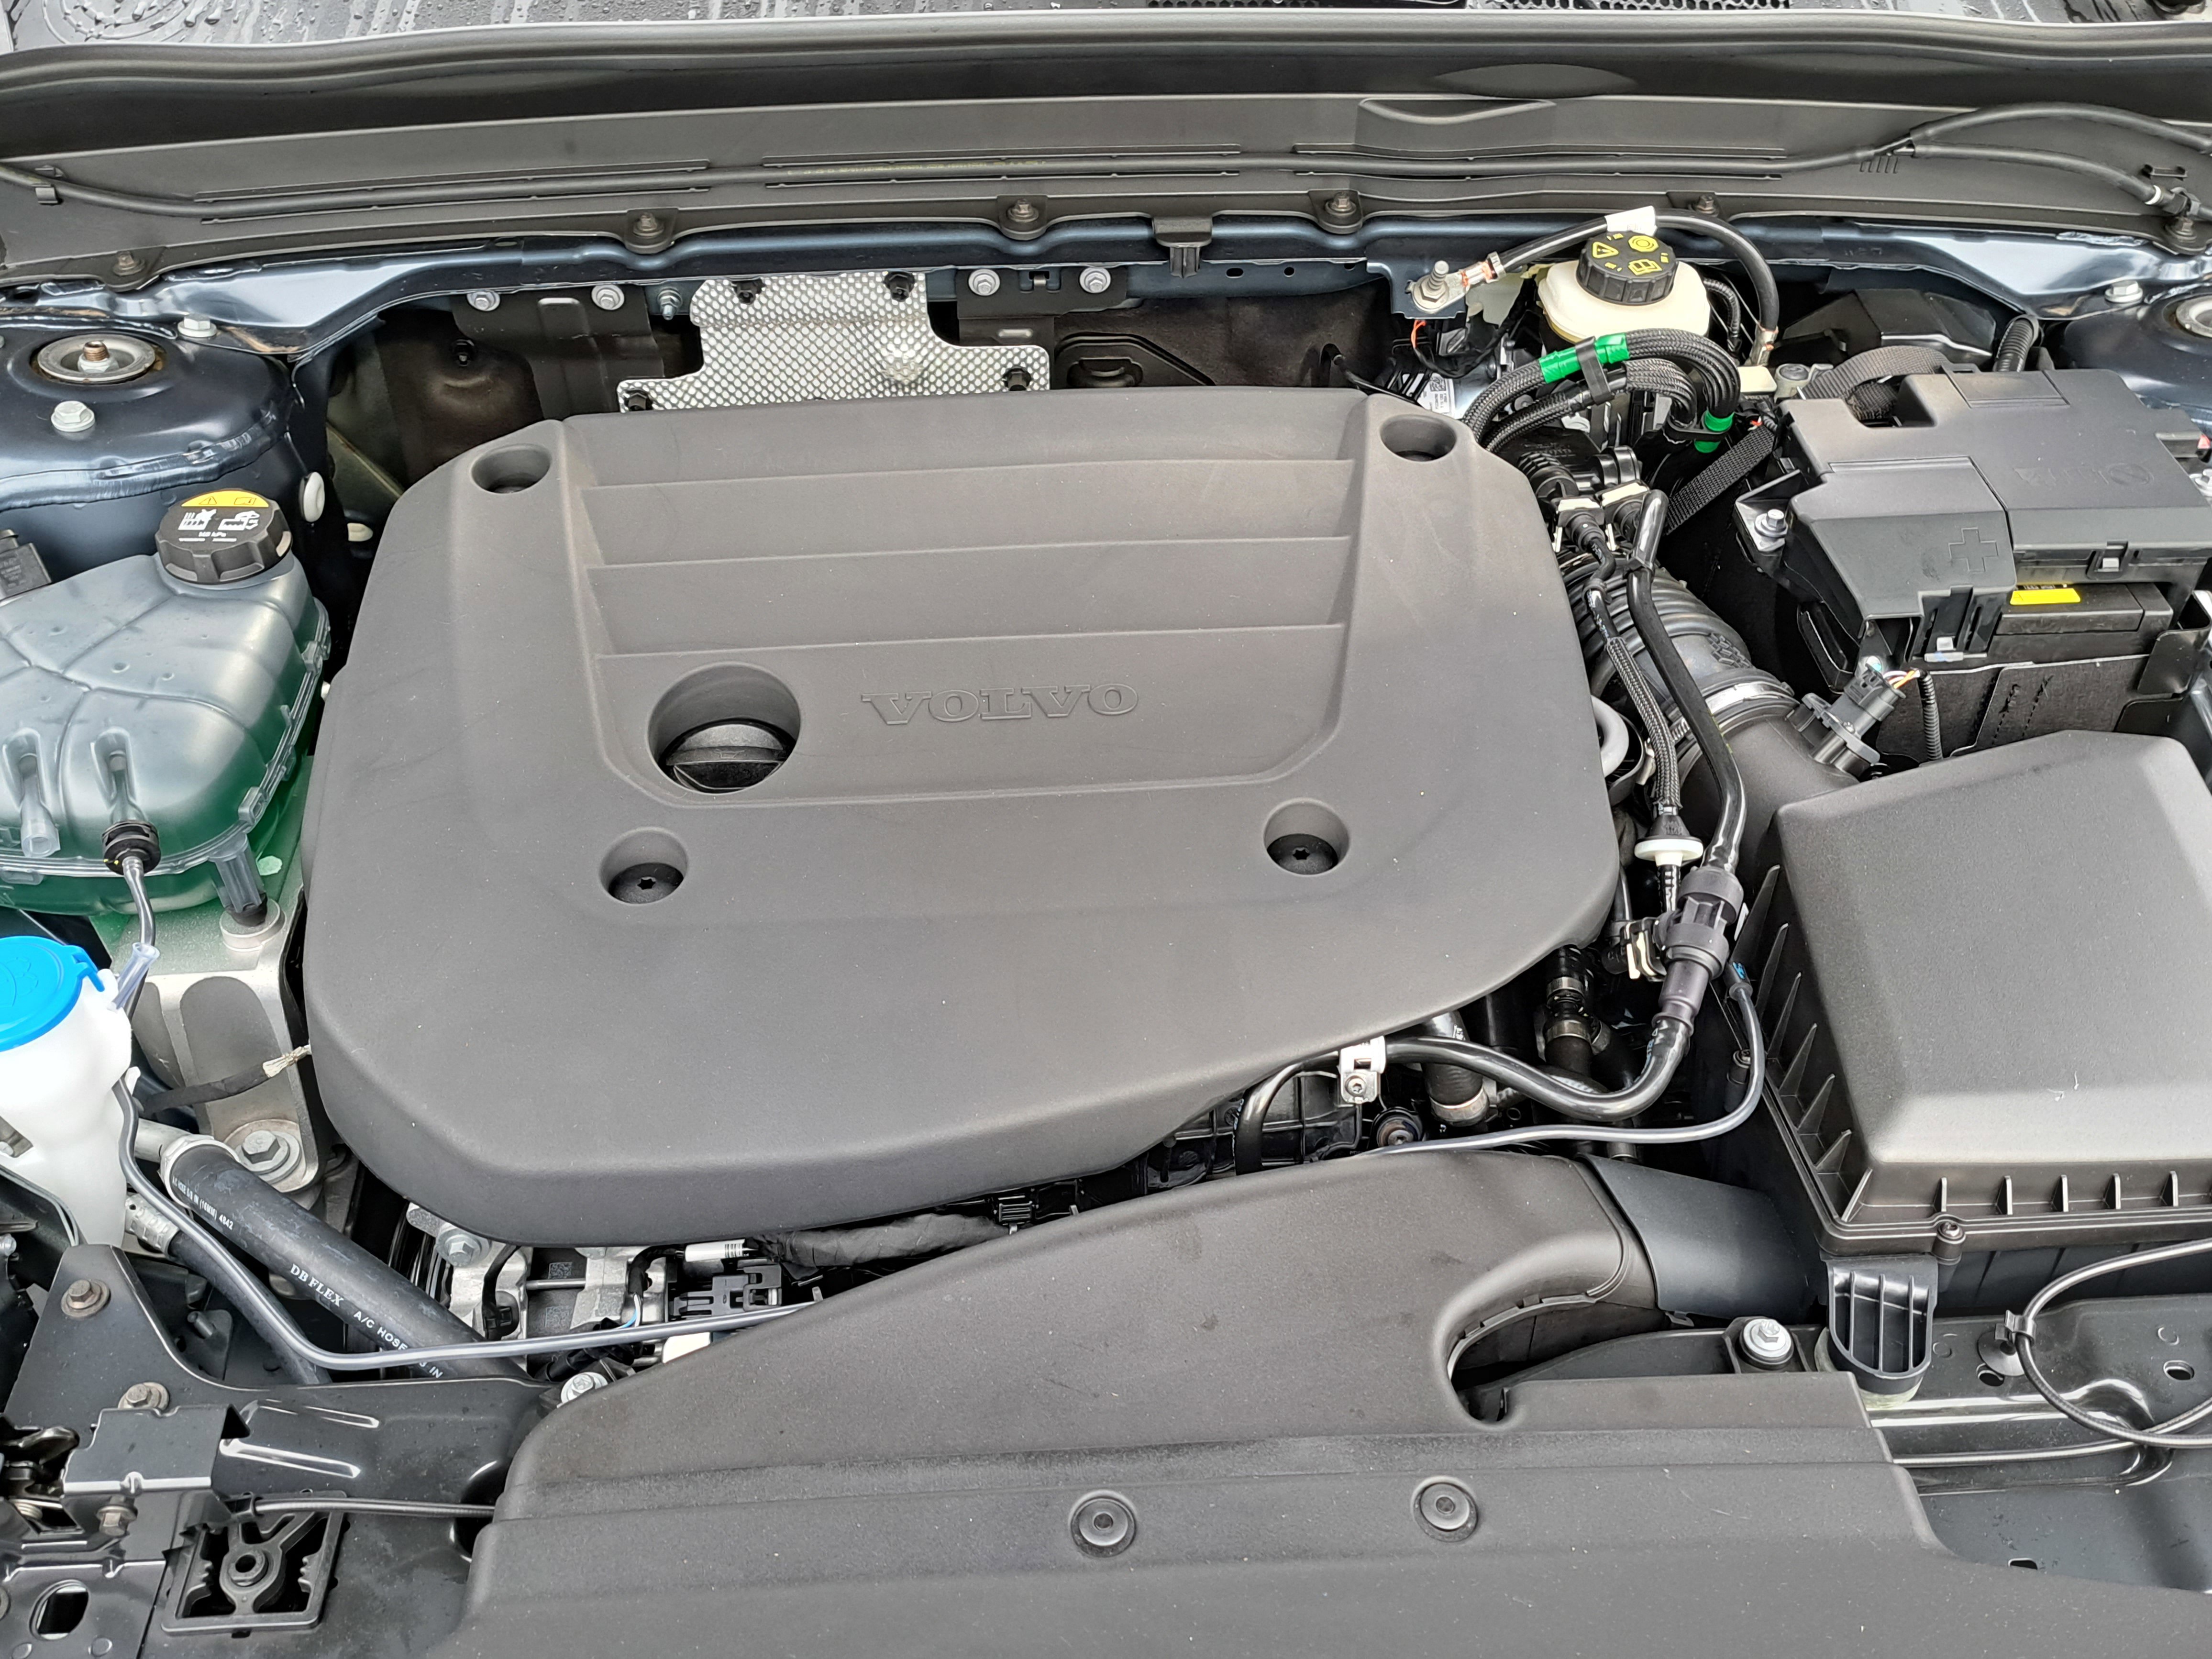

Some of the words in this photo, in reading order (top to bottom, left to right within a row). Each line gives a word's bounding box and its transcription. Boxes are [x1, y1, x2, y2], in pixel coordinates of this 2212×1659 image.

[861, 683, 1139, 725] VOLVO
[199, 1198, 217, 1220] (16MM)
[218, 1214, 234, 1230] 4842
[290, 1263, 309, 1282] DB
[308, 1277, 344, 1307] FLEX
[353, 1311, 375, 1328] A/C
[429, 1366, 443, 1379] IN
